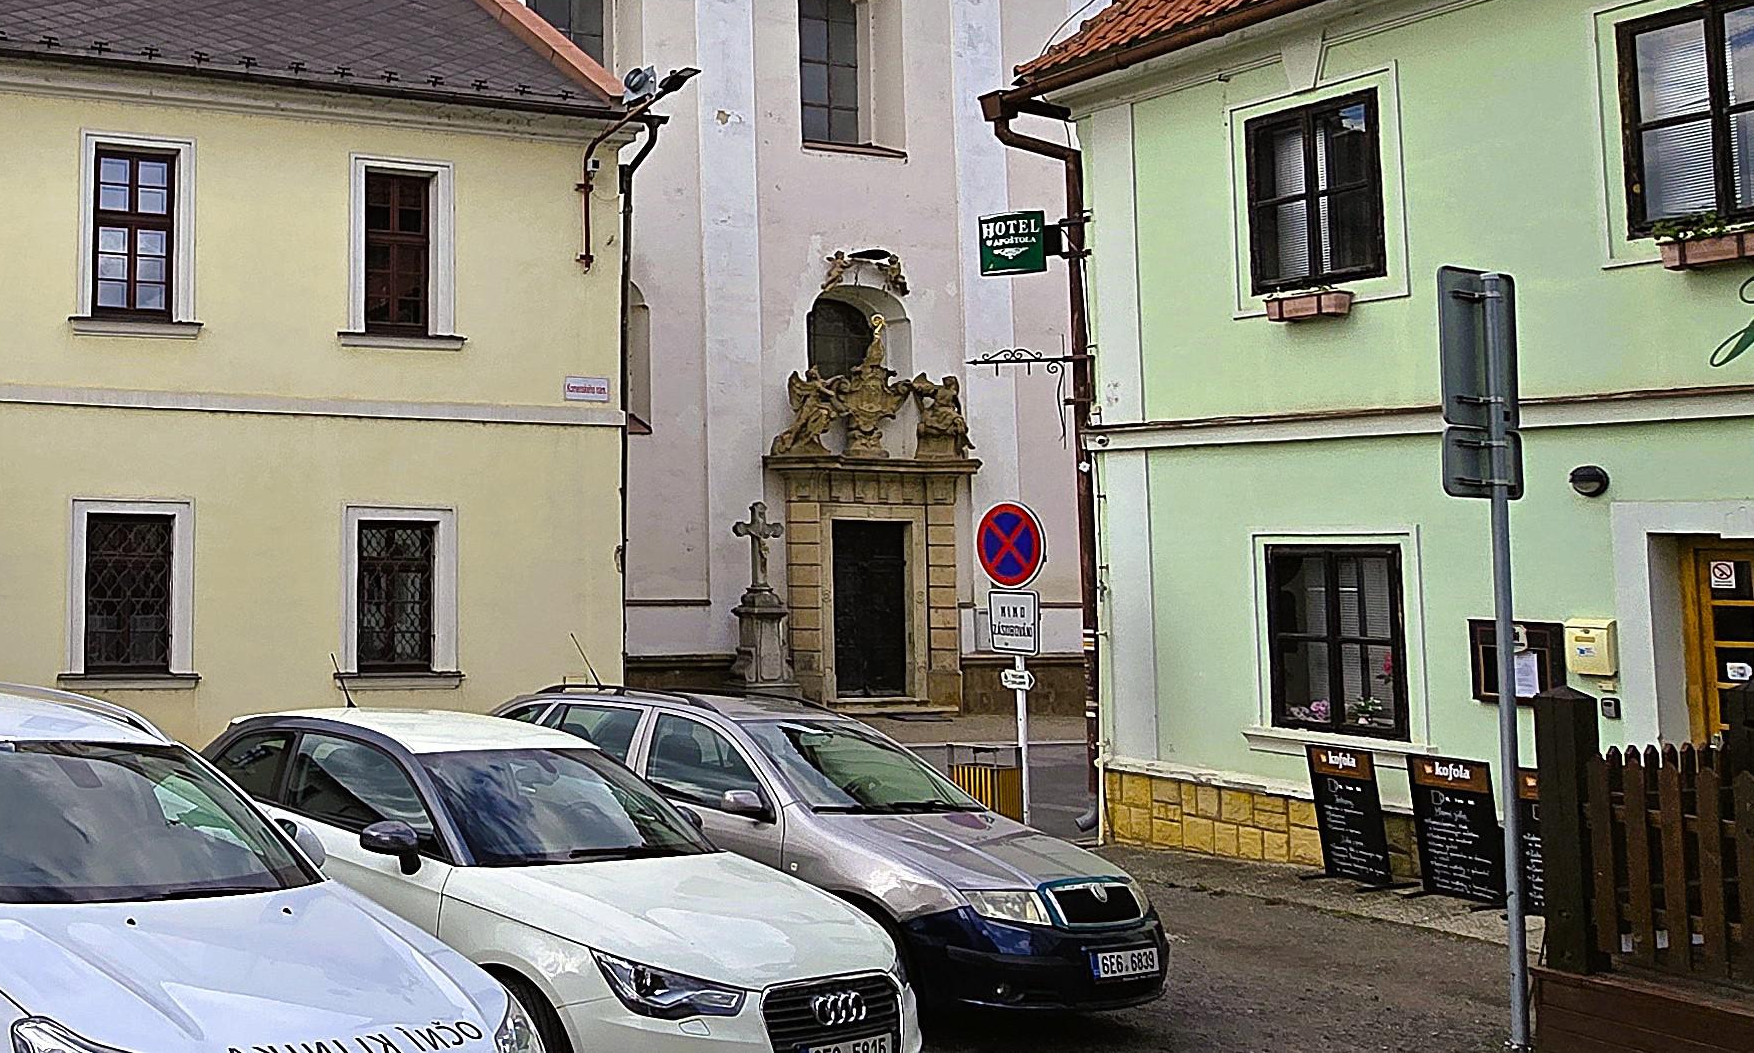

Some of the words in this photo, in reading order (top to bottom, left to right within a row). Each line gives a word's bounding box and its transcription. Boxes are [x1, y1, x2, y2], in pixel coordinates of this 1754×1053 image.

[982, 219, 1040, 239] HOTEL
[1327, 750, 1356, 769] kofola
[1434, 761, 1471, 781] kofola
[1102, 955, 1124, 974] 6E6
[1130, 950, 1155, 972] 6839
